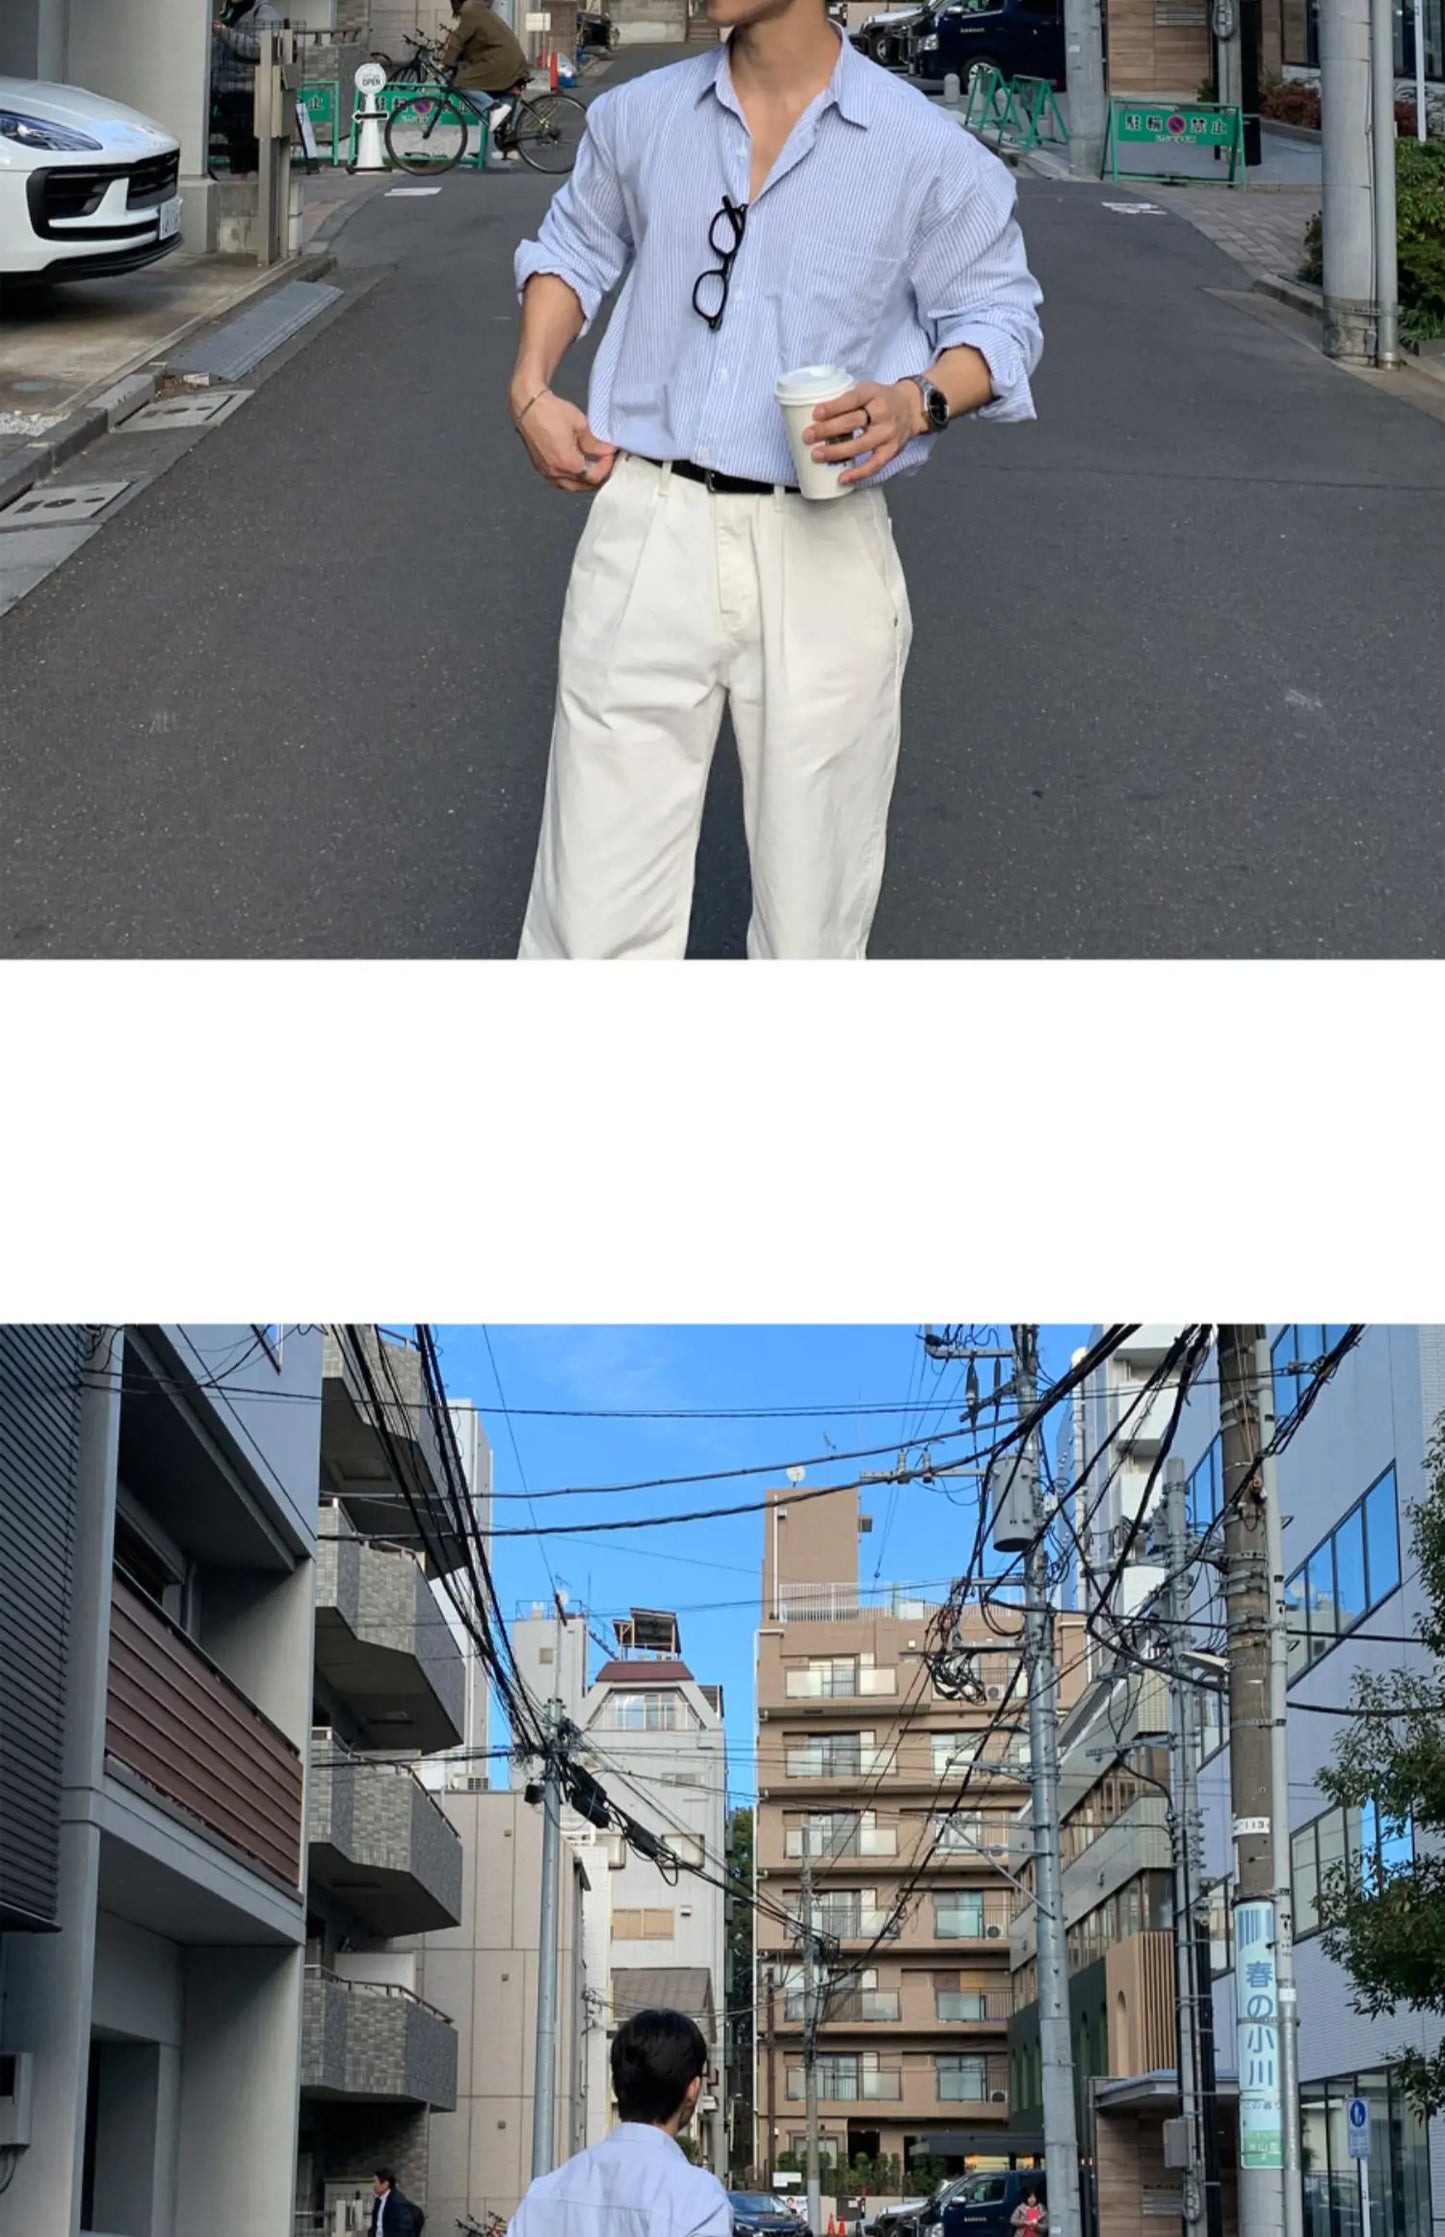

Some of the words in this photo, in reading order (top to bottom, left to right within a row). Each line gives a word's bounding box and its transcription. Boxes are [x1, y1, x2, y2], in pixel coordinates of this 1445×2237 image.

[362, 78, 381, 87] OPEN
[1245, 1960, 1275, 2087] 春の小川
